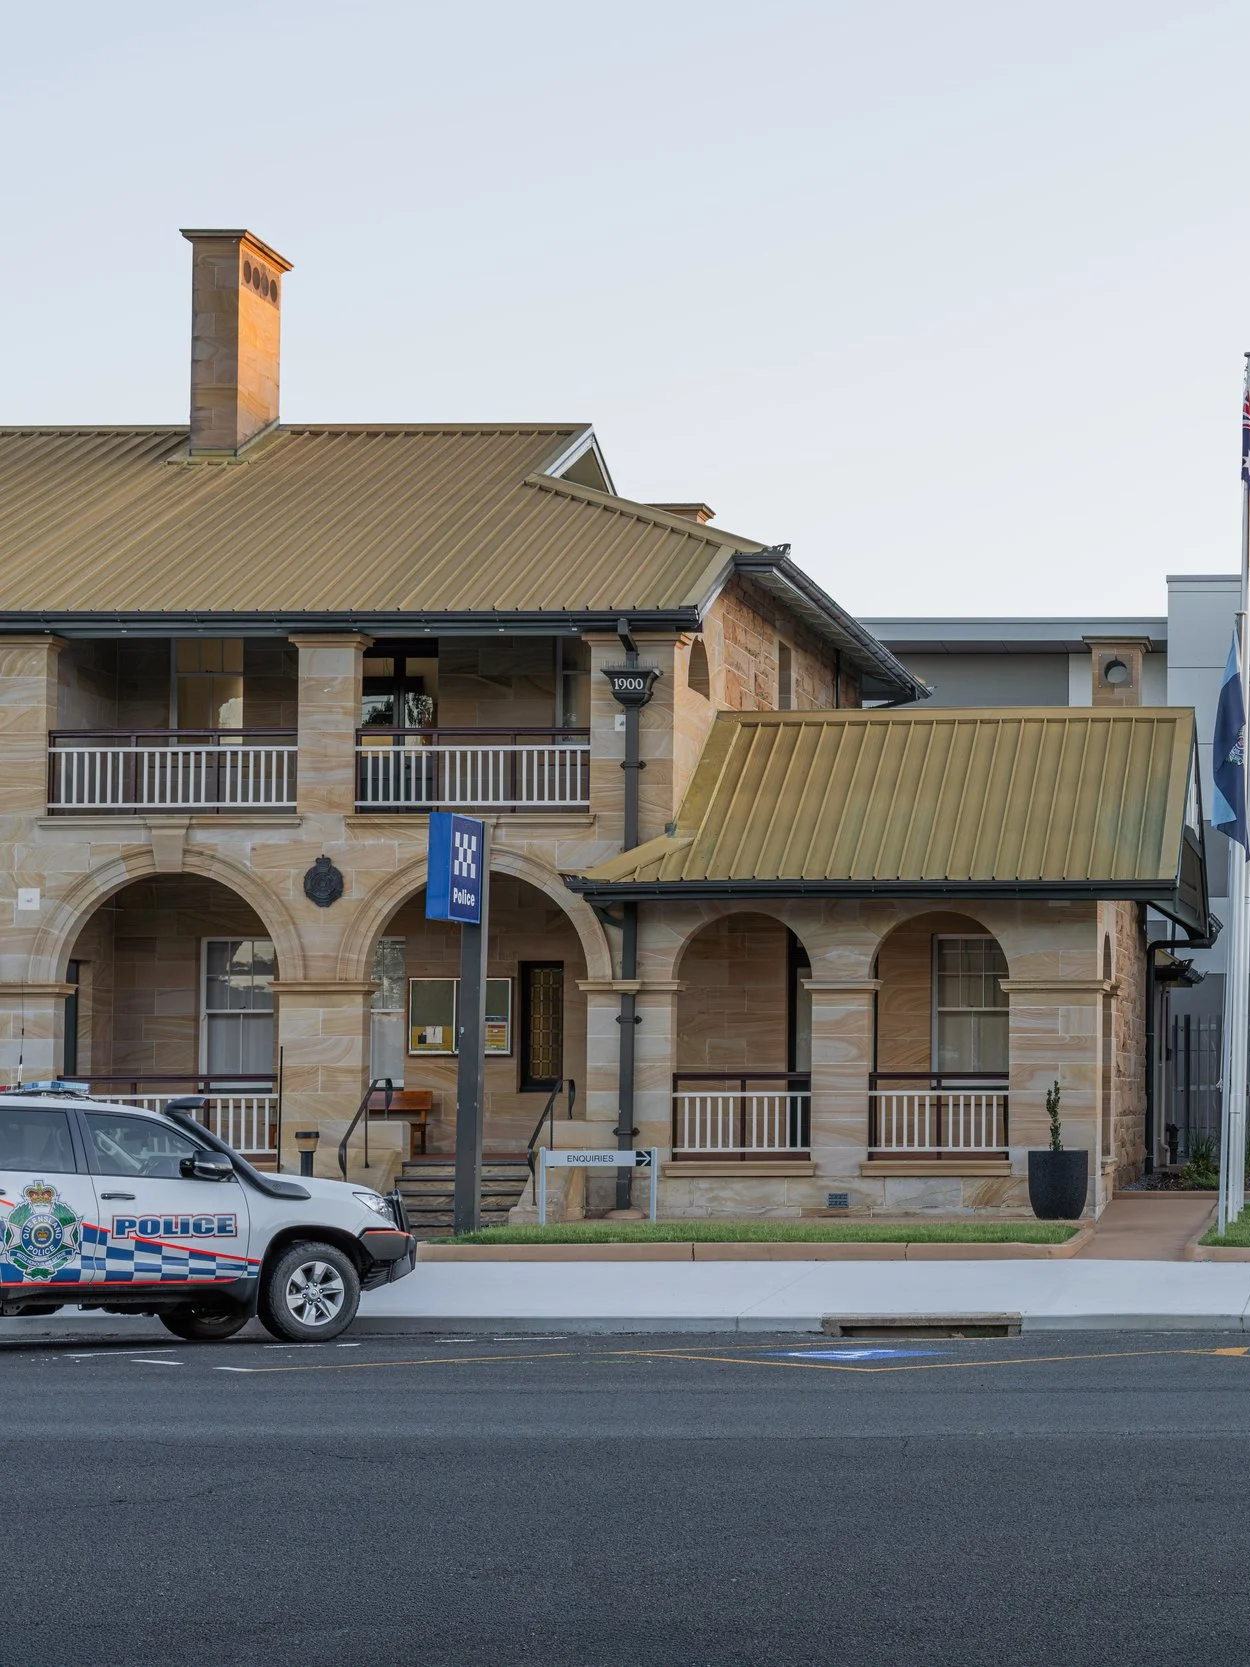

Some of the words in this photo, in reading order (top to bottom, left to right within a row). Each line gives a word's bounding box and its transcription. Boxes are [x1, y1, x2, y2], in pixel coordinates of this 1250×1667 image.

[614, 678, 644, 690] 1900
[453, 887, 476, 907] Police
[567, 1155, 614, 1163] ENQUIRIES
[23, 1214, 62, 1240] QUEENSLAND
[113, 1215, 236, 1238] POLICE
[27, 1245, 56, 1256] POLICE
